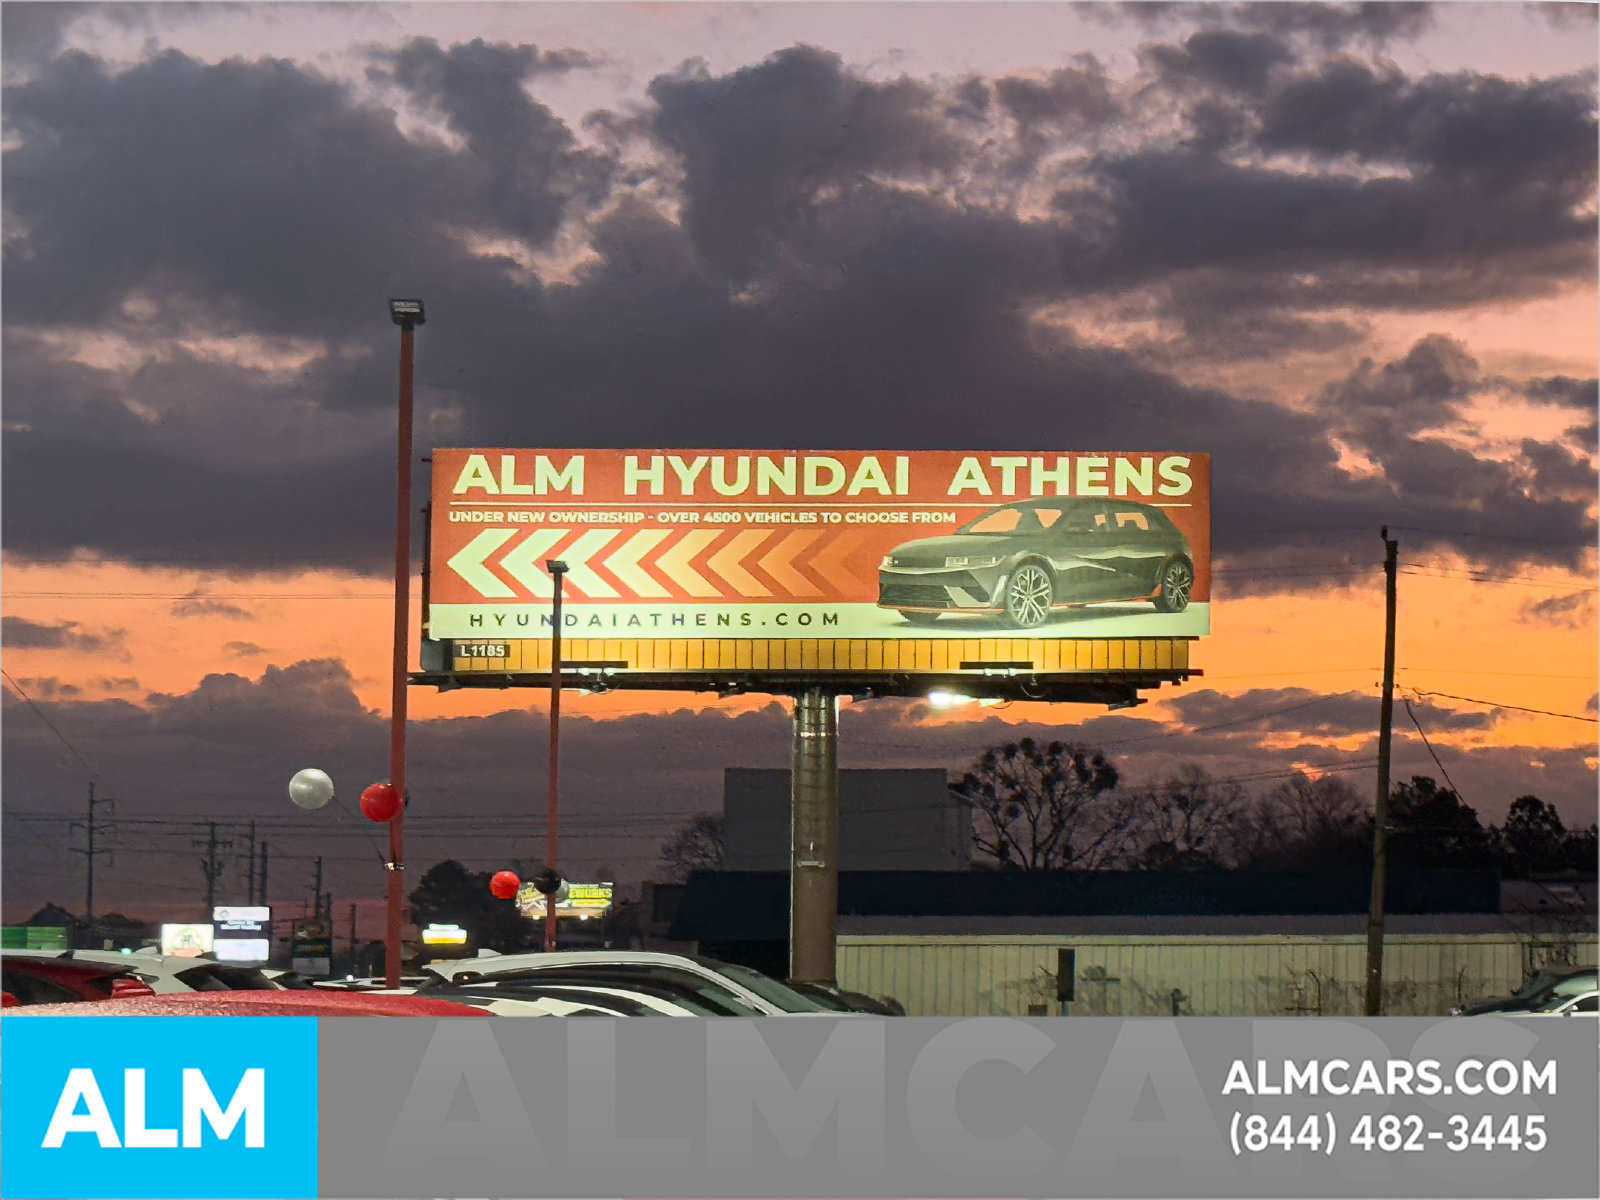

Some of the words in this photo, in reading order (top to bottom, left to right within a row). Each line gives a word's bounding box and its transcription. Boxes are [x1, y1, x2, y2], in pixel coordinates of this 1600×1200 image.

[453, 454, 585, 496] ALM
[623, 455, 910, 497] HYUNDAI
[947, 455, 1193, 497] ATHENS
[449, 511, 504, 523] UNDER
[507, 511, 545, 523] NEW
[549, 511, 645, 524] OWNERSHIP
[657, 511, 699, 524] OVER
[744, 511, 818, 524] VEHICLES
[820, 511, 842, 524] TO
[845, 511, 909, 524] CHOOSE
[911, 511, 957, 524] FROM
[469, 613, 839, 628] HYUNDAIATHENS.COM
